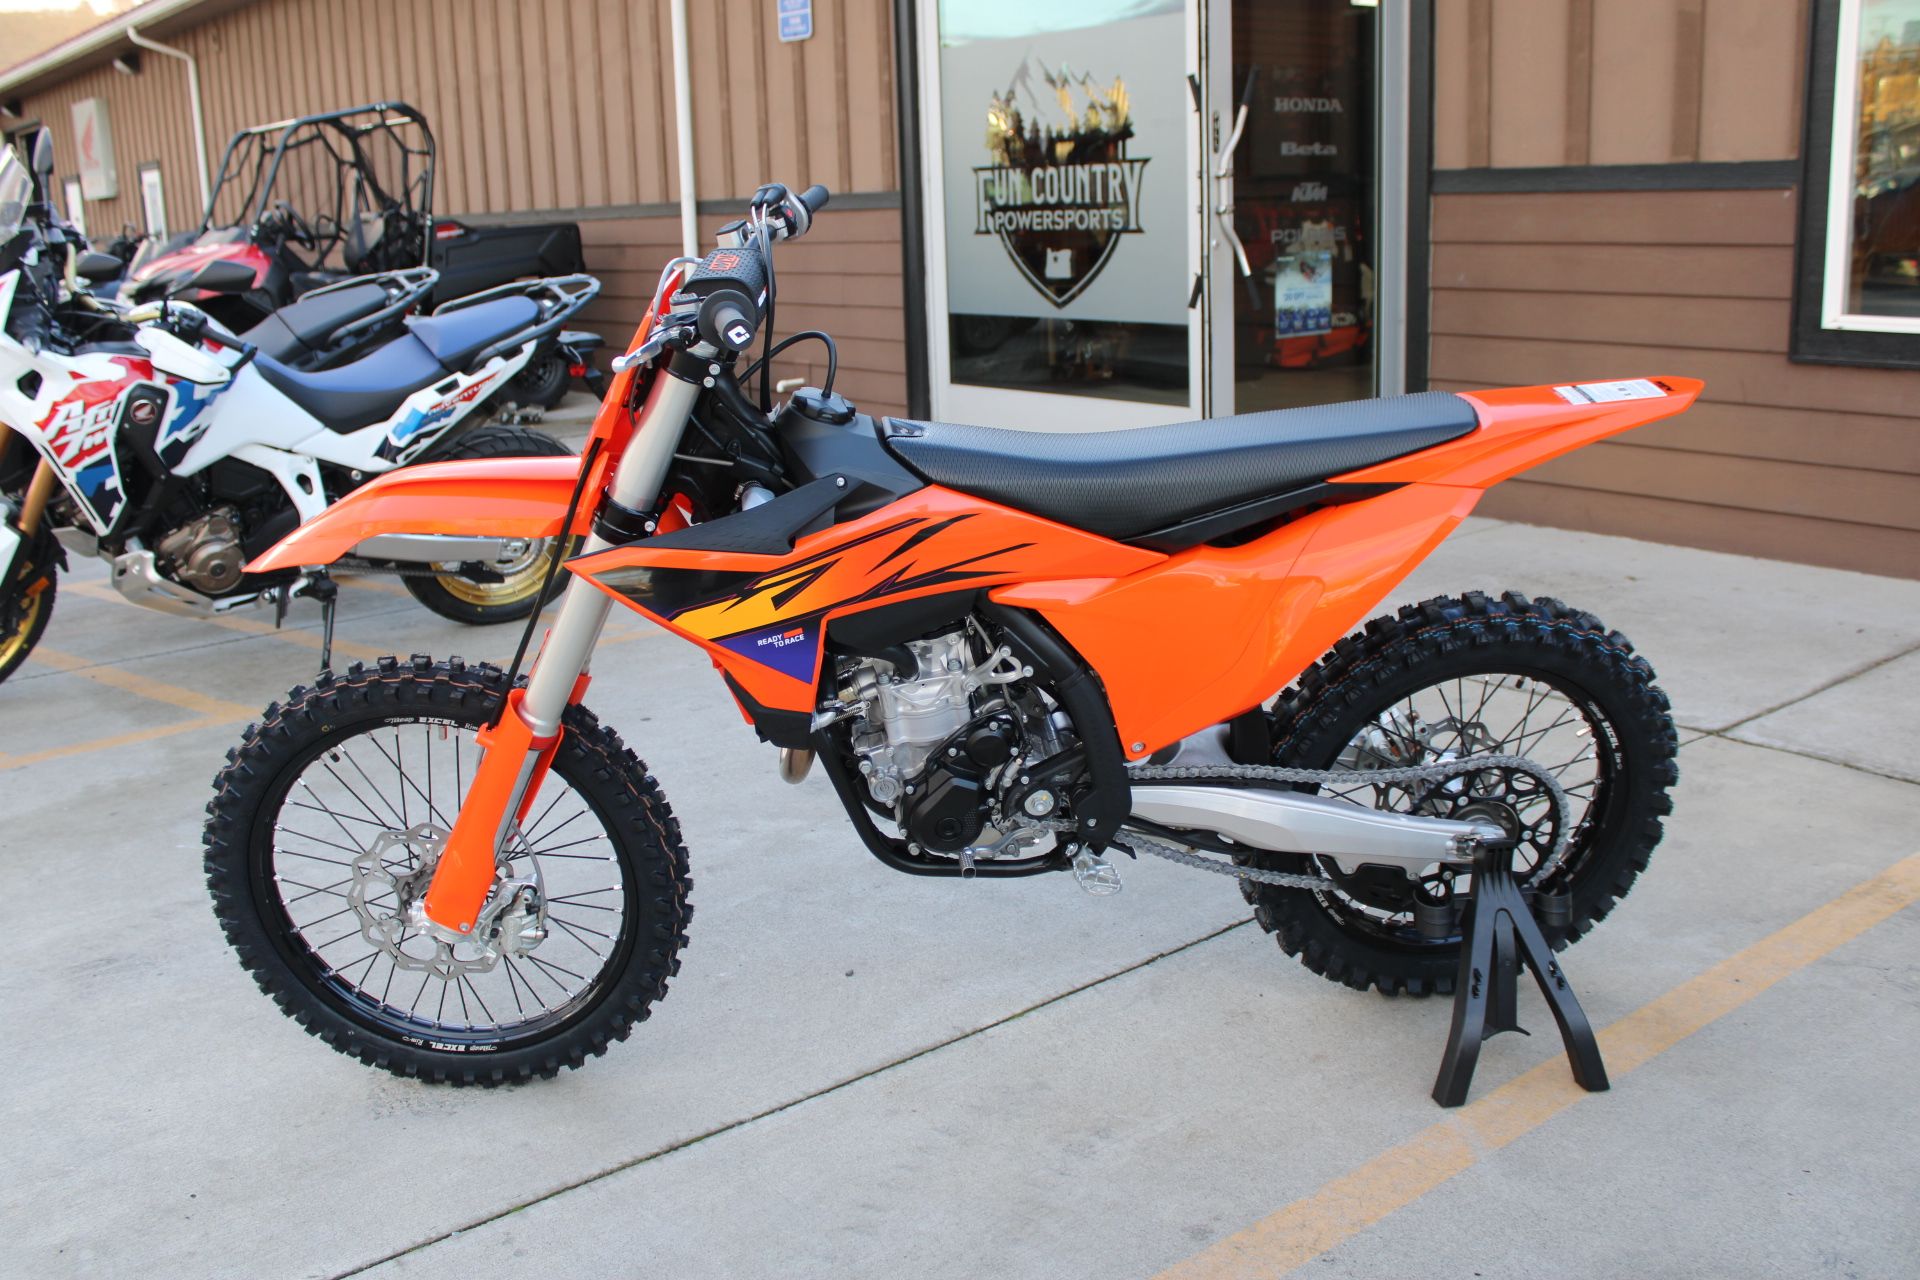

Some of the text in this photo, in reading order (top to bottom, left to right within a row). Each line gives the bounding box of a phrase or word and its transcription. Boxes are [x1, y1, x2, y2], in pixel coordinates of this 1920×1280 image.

[1274, 97, 1343, 112] HONDA
[1281, 141, 1338, 156] Beta
[974, 158, 1150, 233] FUN COUNTRY
[1291, 182, 1328, 203] KTM
[994, 209, 1124, 231] POWERSPORTS
[757, 634, 782, 646] READY
[773, 634, 804, 648] TO RACE
[419, 717, 459, 726] EXCEL
[429, 1041, 466, 1052] EXCEL
